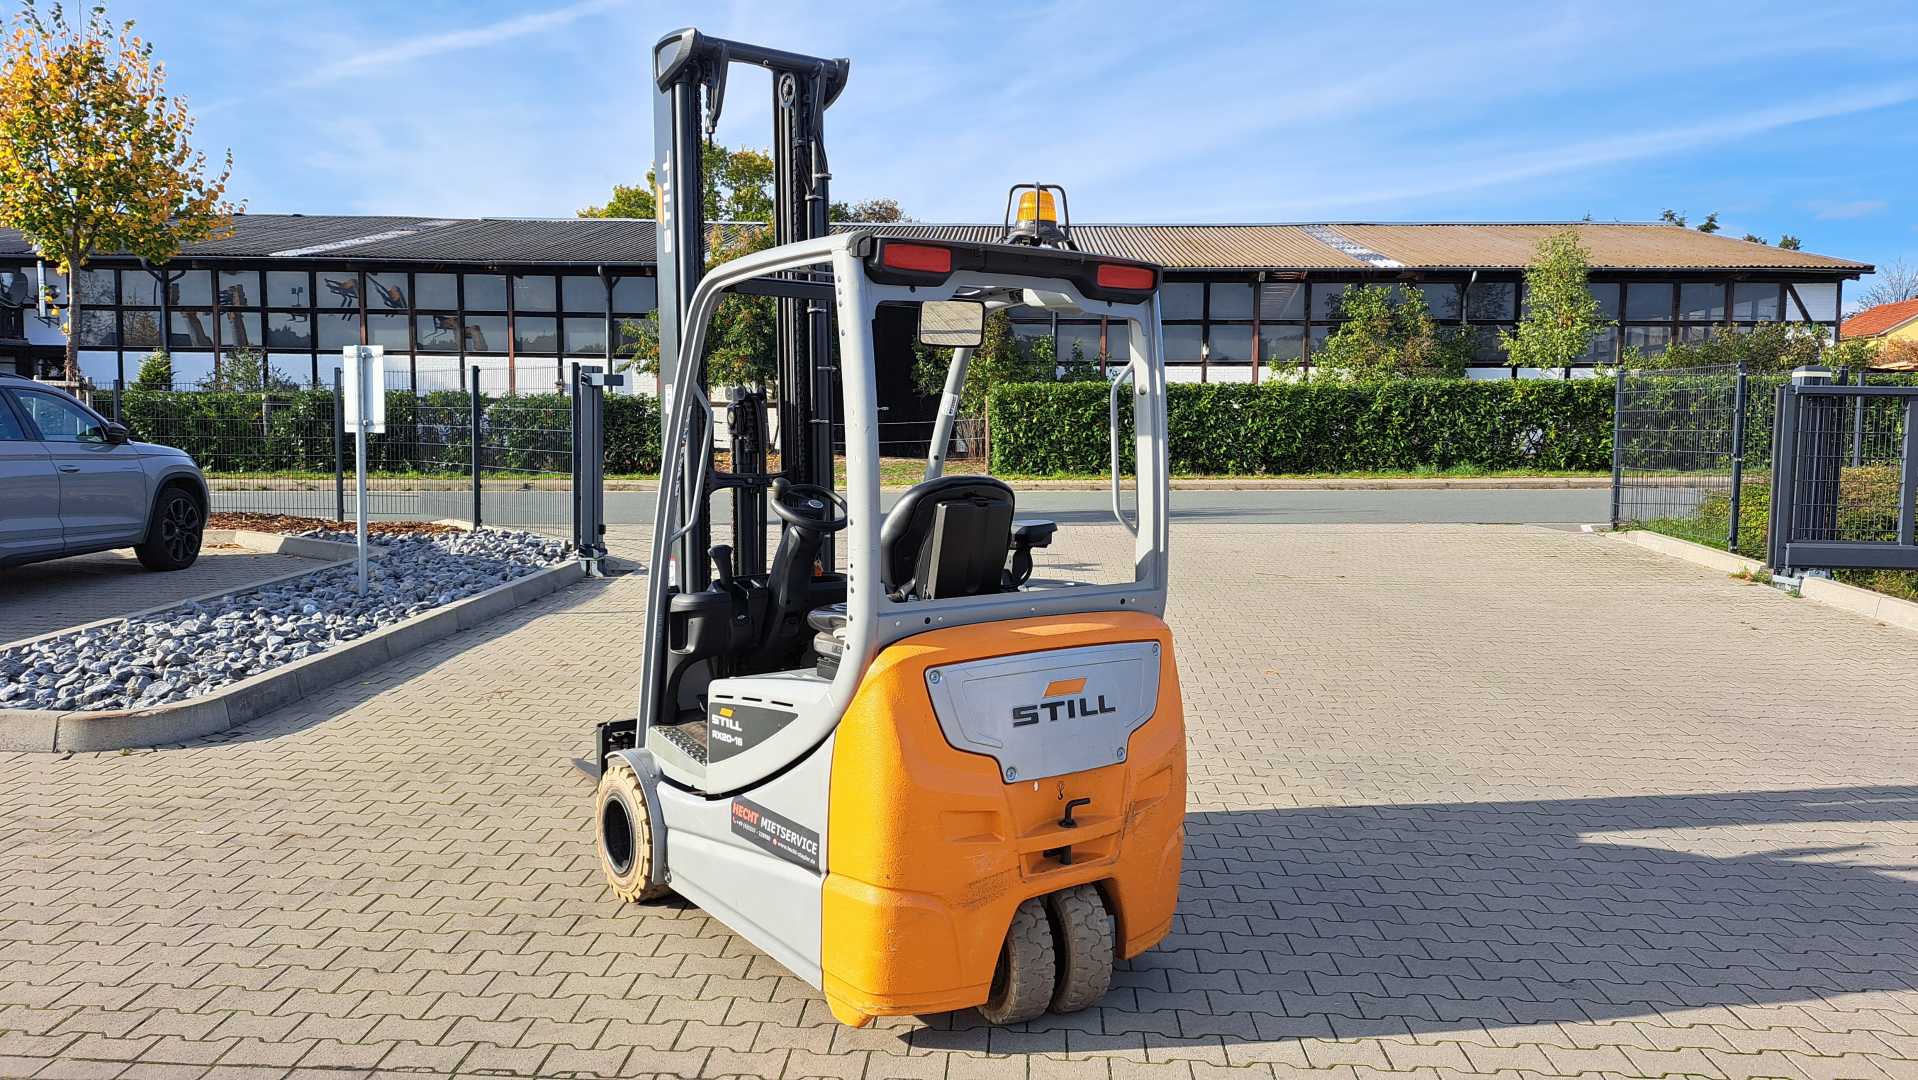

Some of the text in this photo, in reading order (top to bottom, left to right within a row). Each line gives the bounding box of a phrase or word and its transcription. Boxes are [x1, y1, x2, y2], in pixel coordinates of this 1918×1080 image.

[663, 150, 671, 253] STILL
[712, 714, 743, 731] STILL
[1012, 695, 1116, 728] STILL
[733, 802, 759, 825] HECHT
[760, 816, 818, 855] MIETSERVICE
